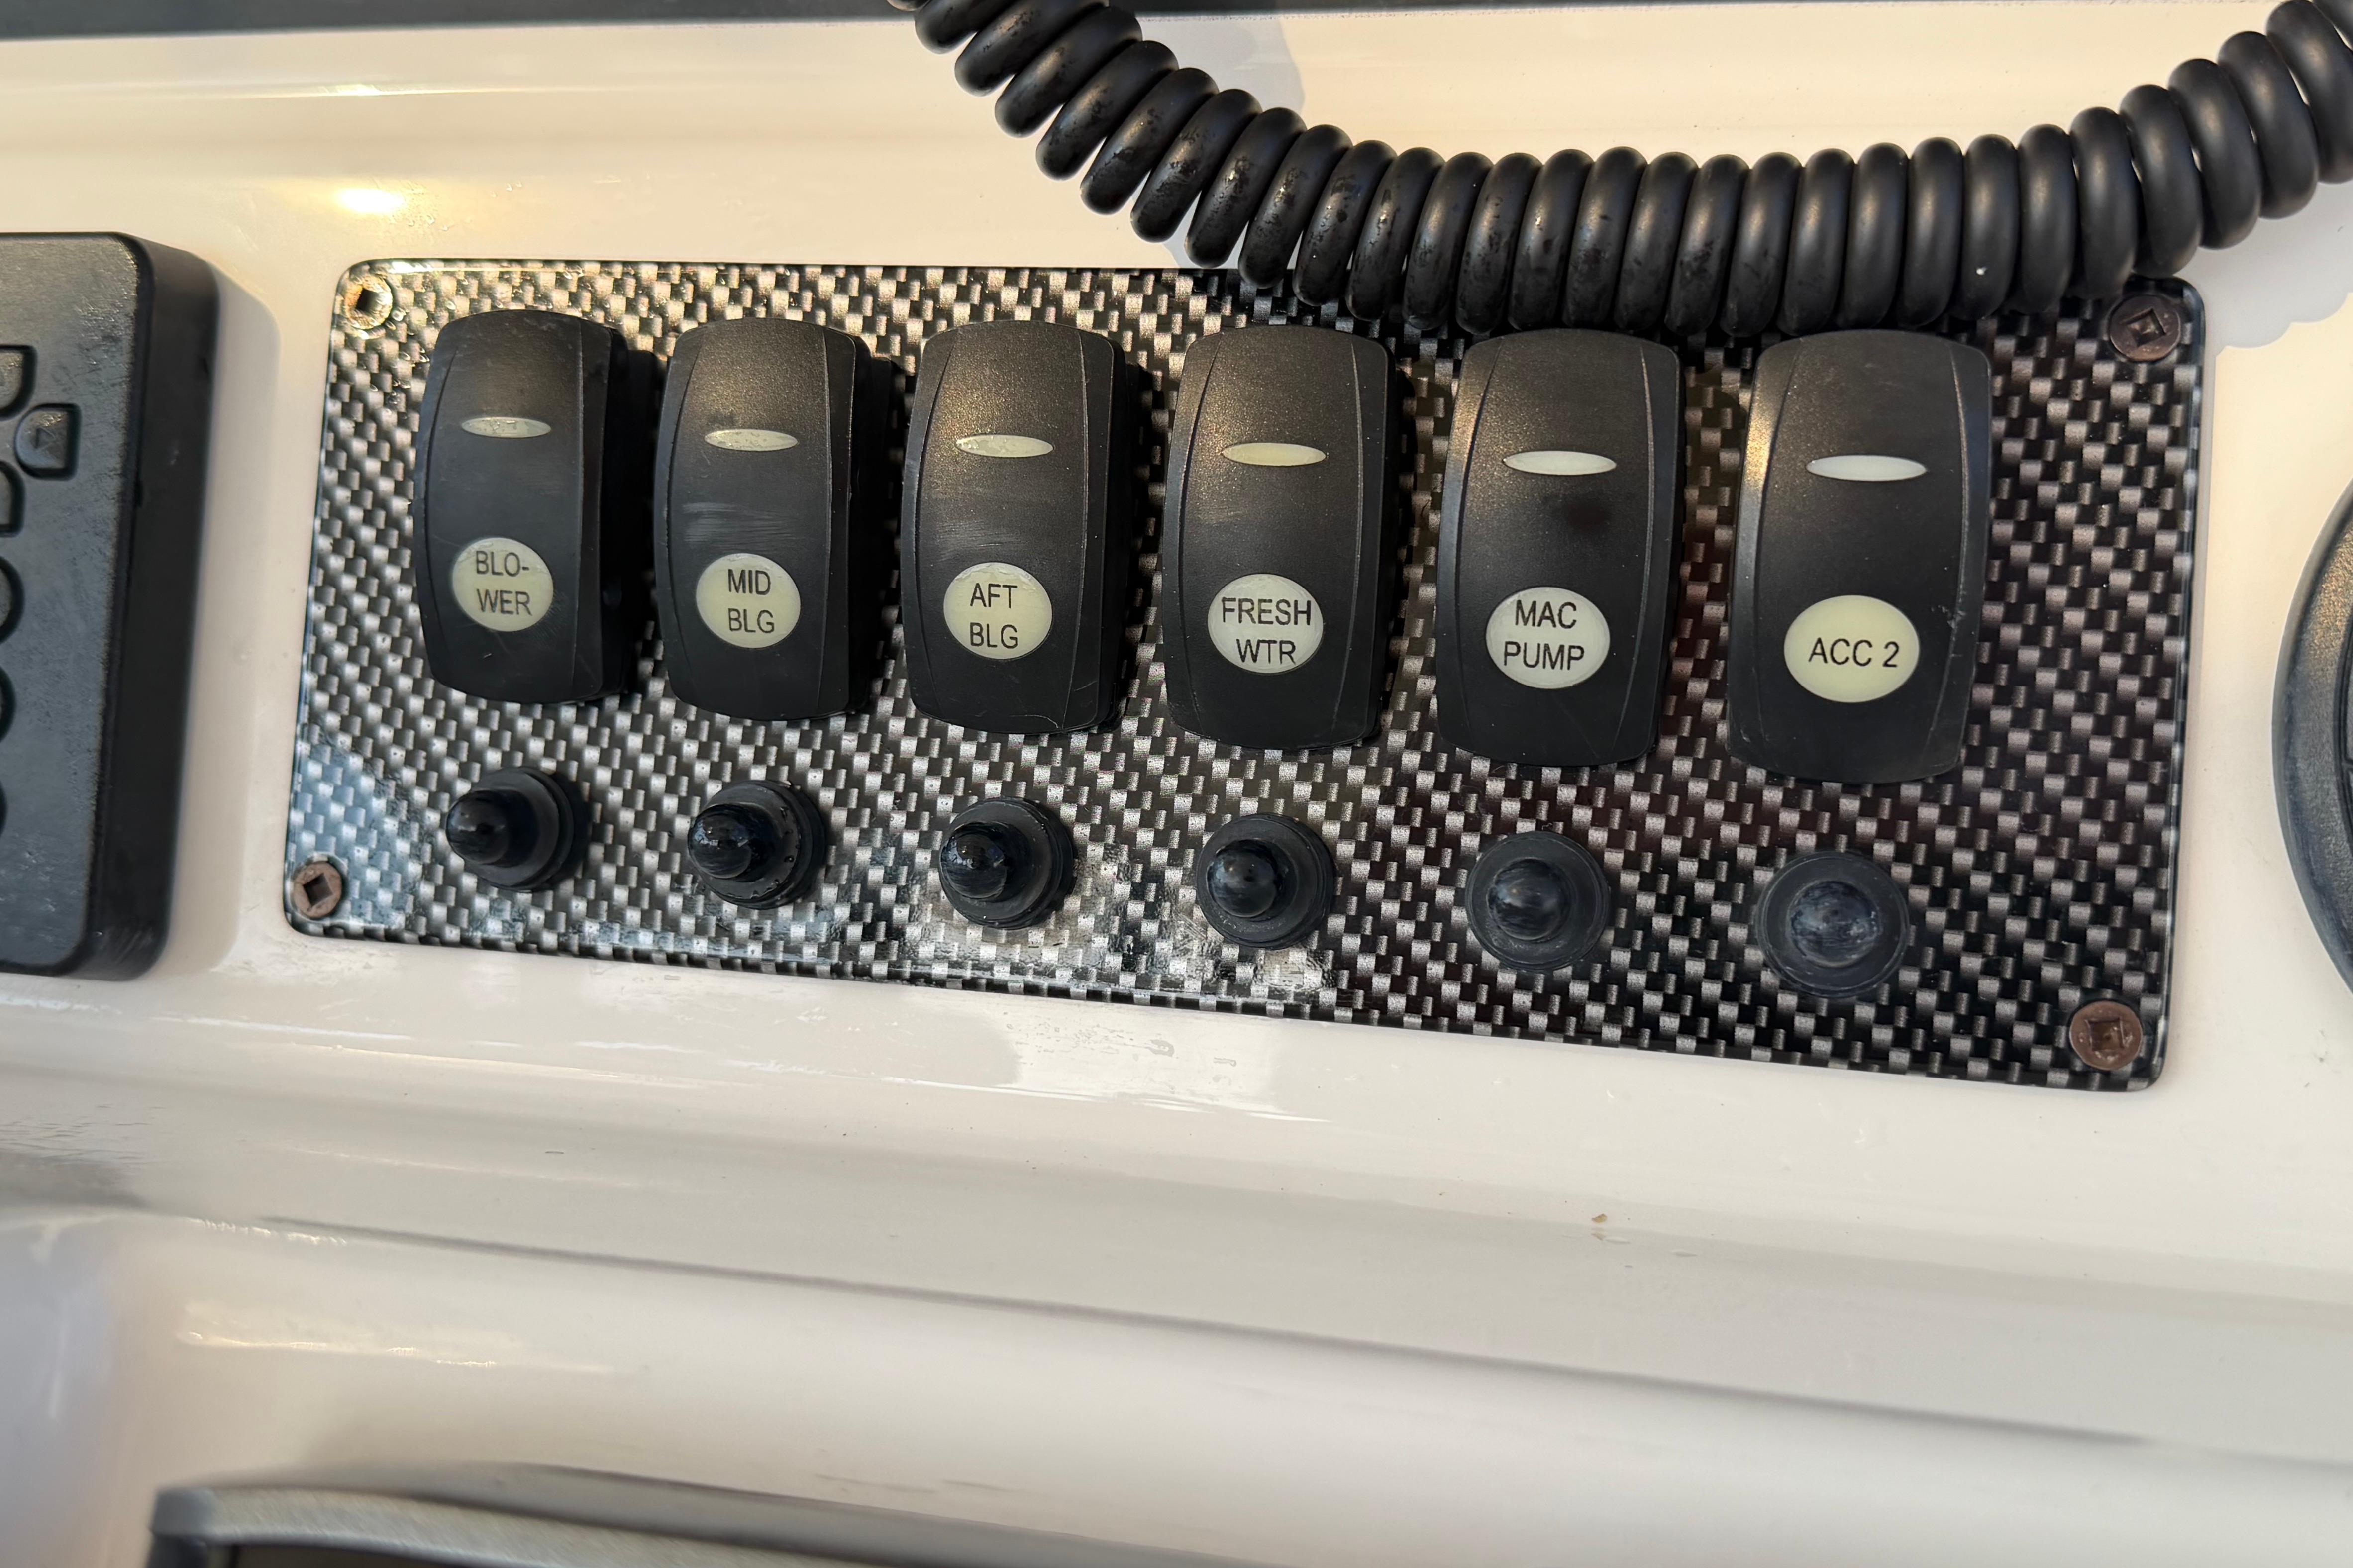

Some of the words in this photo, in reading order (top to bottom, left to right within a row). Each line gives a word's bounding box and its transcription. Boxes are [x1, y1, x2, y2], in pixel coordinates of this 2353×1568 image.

[476, 550, 530, 577] BLO-
[727, 569, 772, 595] MID
[476, 588, 533, 616] WER
[969, 583, 1018, 609] AFT
[727, 608, 775, 634] BLG
[1221, 596, 1312, 626] FRESH
[1515, 599, 1577, 629] MAC
[969, 622, 1019, 649] BLG
[1235, 638, 1297, 665] WTR
[1503, 641, 1585, 671] PUMP
[1808, 637, 1873, 667] ACC
[1882, 641, 1900, 668] 2
